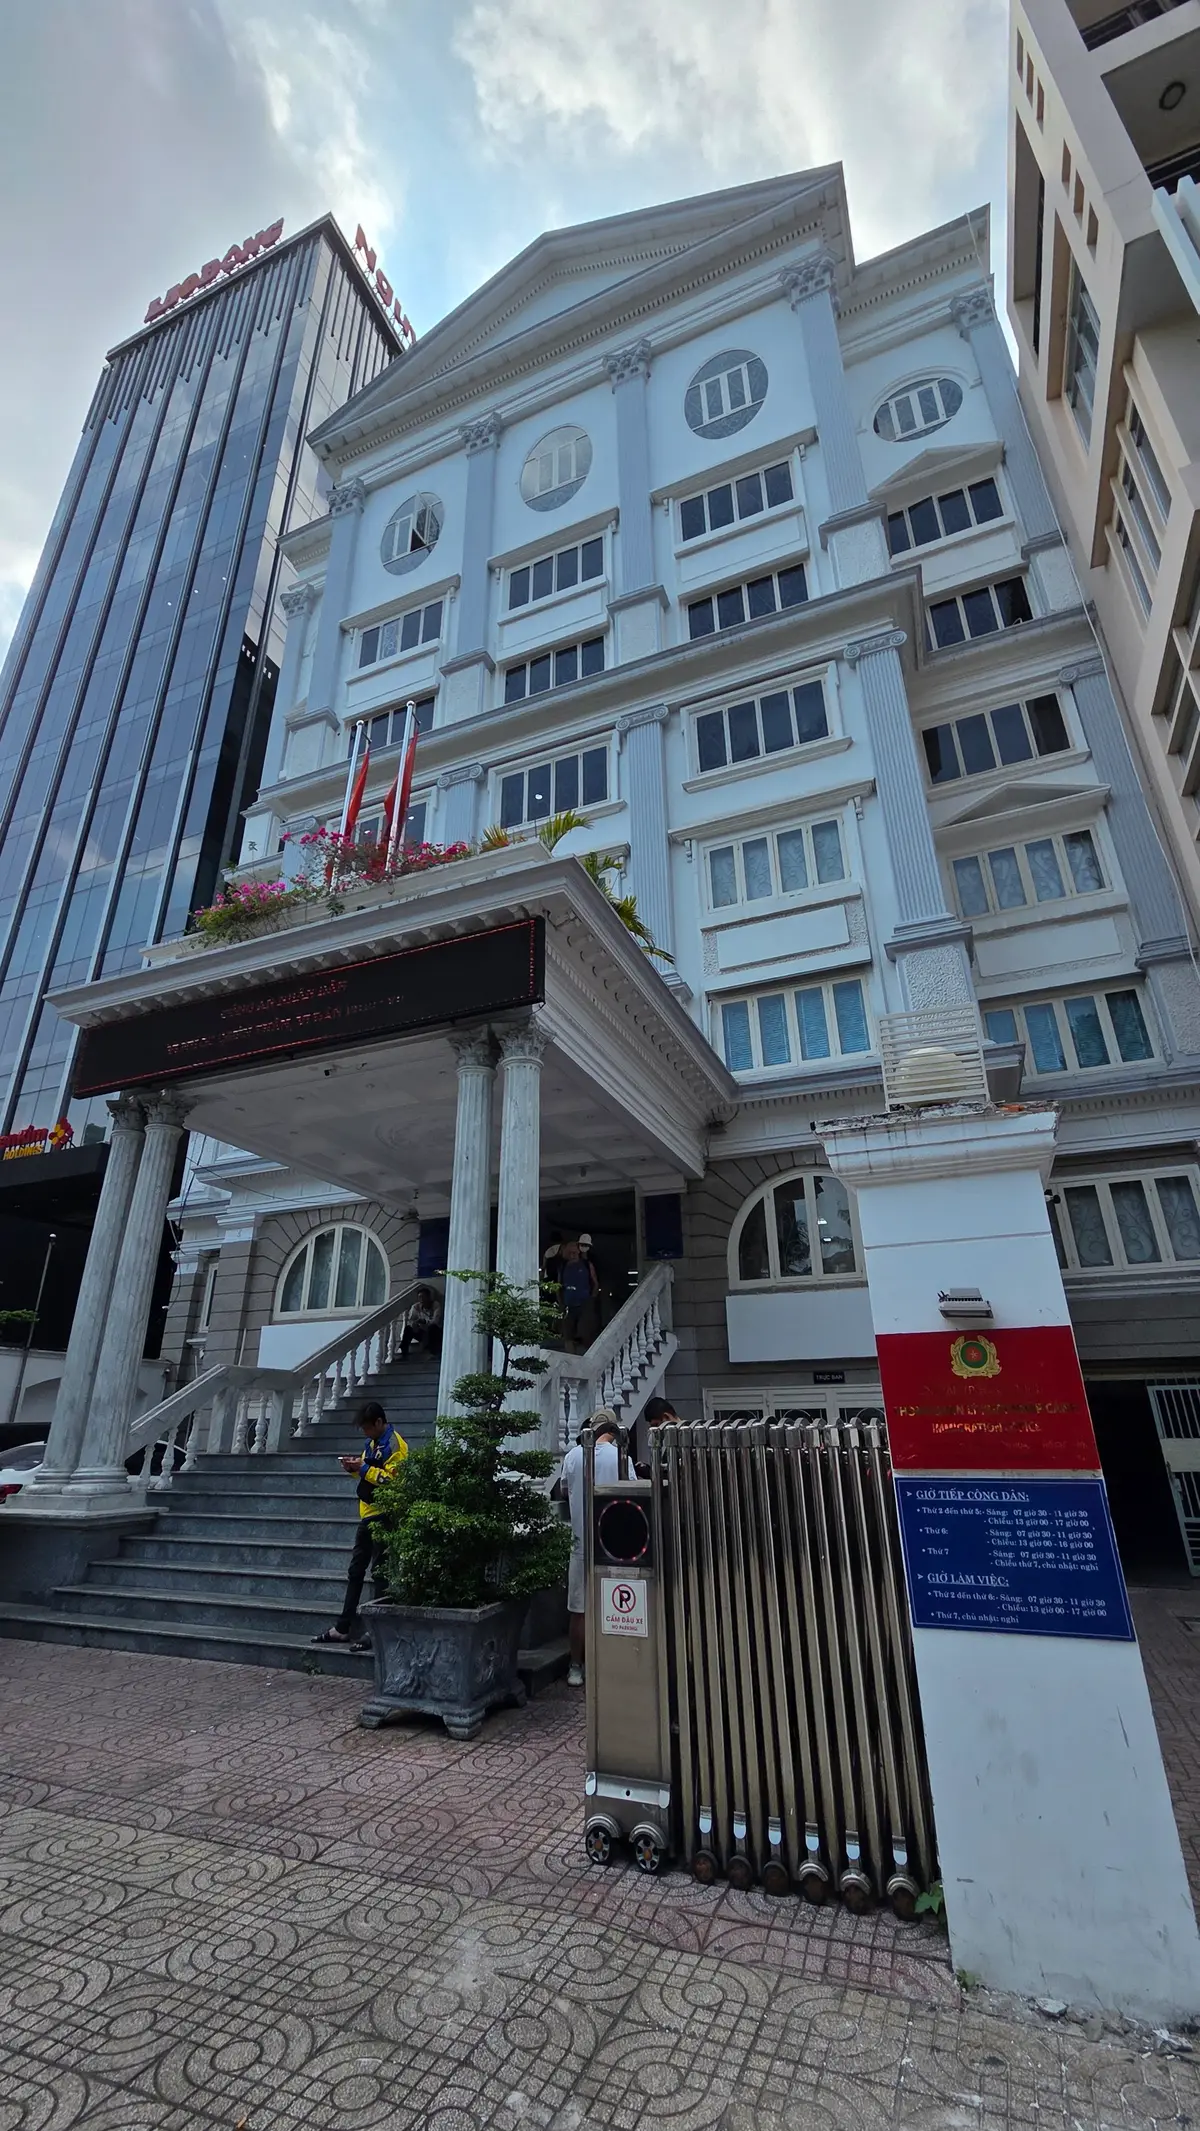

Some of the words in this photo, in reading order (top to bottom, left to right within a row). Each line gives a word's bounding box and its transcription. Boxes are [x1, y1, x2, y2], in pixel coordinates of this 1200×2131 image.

[3, 1145, 43, 1160] HOLDINGS
[916, 1488, 937, 1500] GIỜ
[938, 1487, 964, 1500] TIẾP
[967, 1488, 999, 1501] CÔNG
[1001, 1489, 1029, 1501] DÂN:
[922, 1506, 937, 1514] Thứ
[1038, 1509, 1047, 1517] 30
[1078, 1510, 1088, 1518] 30
[1041, 1530, 1051, 1538] 30
[1019, 1539, 1028, 1547] 13
[1084, 1541, 1094, 1549] 00
[927, 1570, 948, 1583] GIỜ
[950, 1572, 975, 1585] LÀM
[977, 1573, 1009, 1587] VIỆC:
[933, 1590, 949, 1598] Thứ
[1028, 1595, 1037, 1603] 07
[1095, 1599, 1106, 1607] 30
[936, 1611, 952, 1619] Thứ
[1030, 1605, 1039, 1613] 13
[1071, 1607, 1080, 1615] 17
[1096, 1609, 1107, 1617] 00
[636, 1617, 643, 1625] XE
